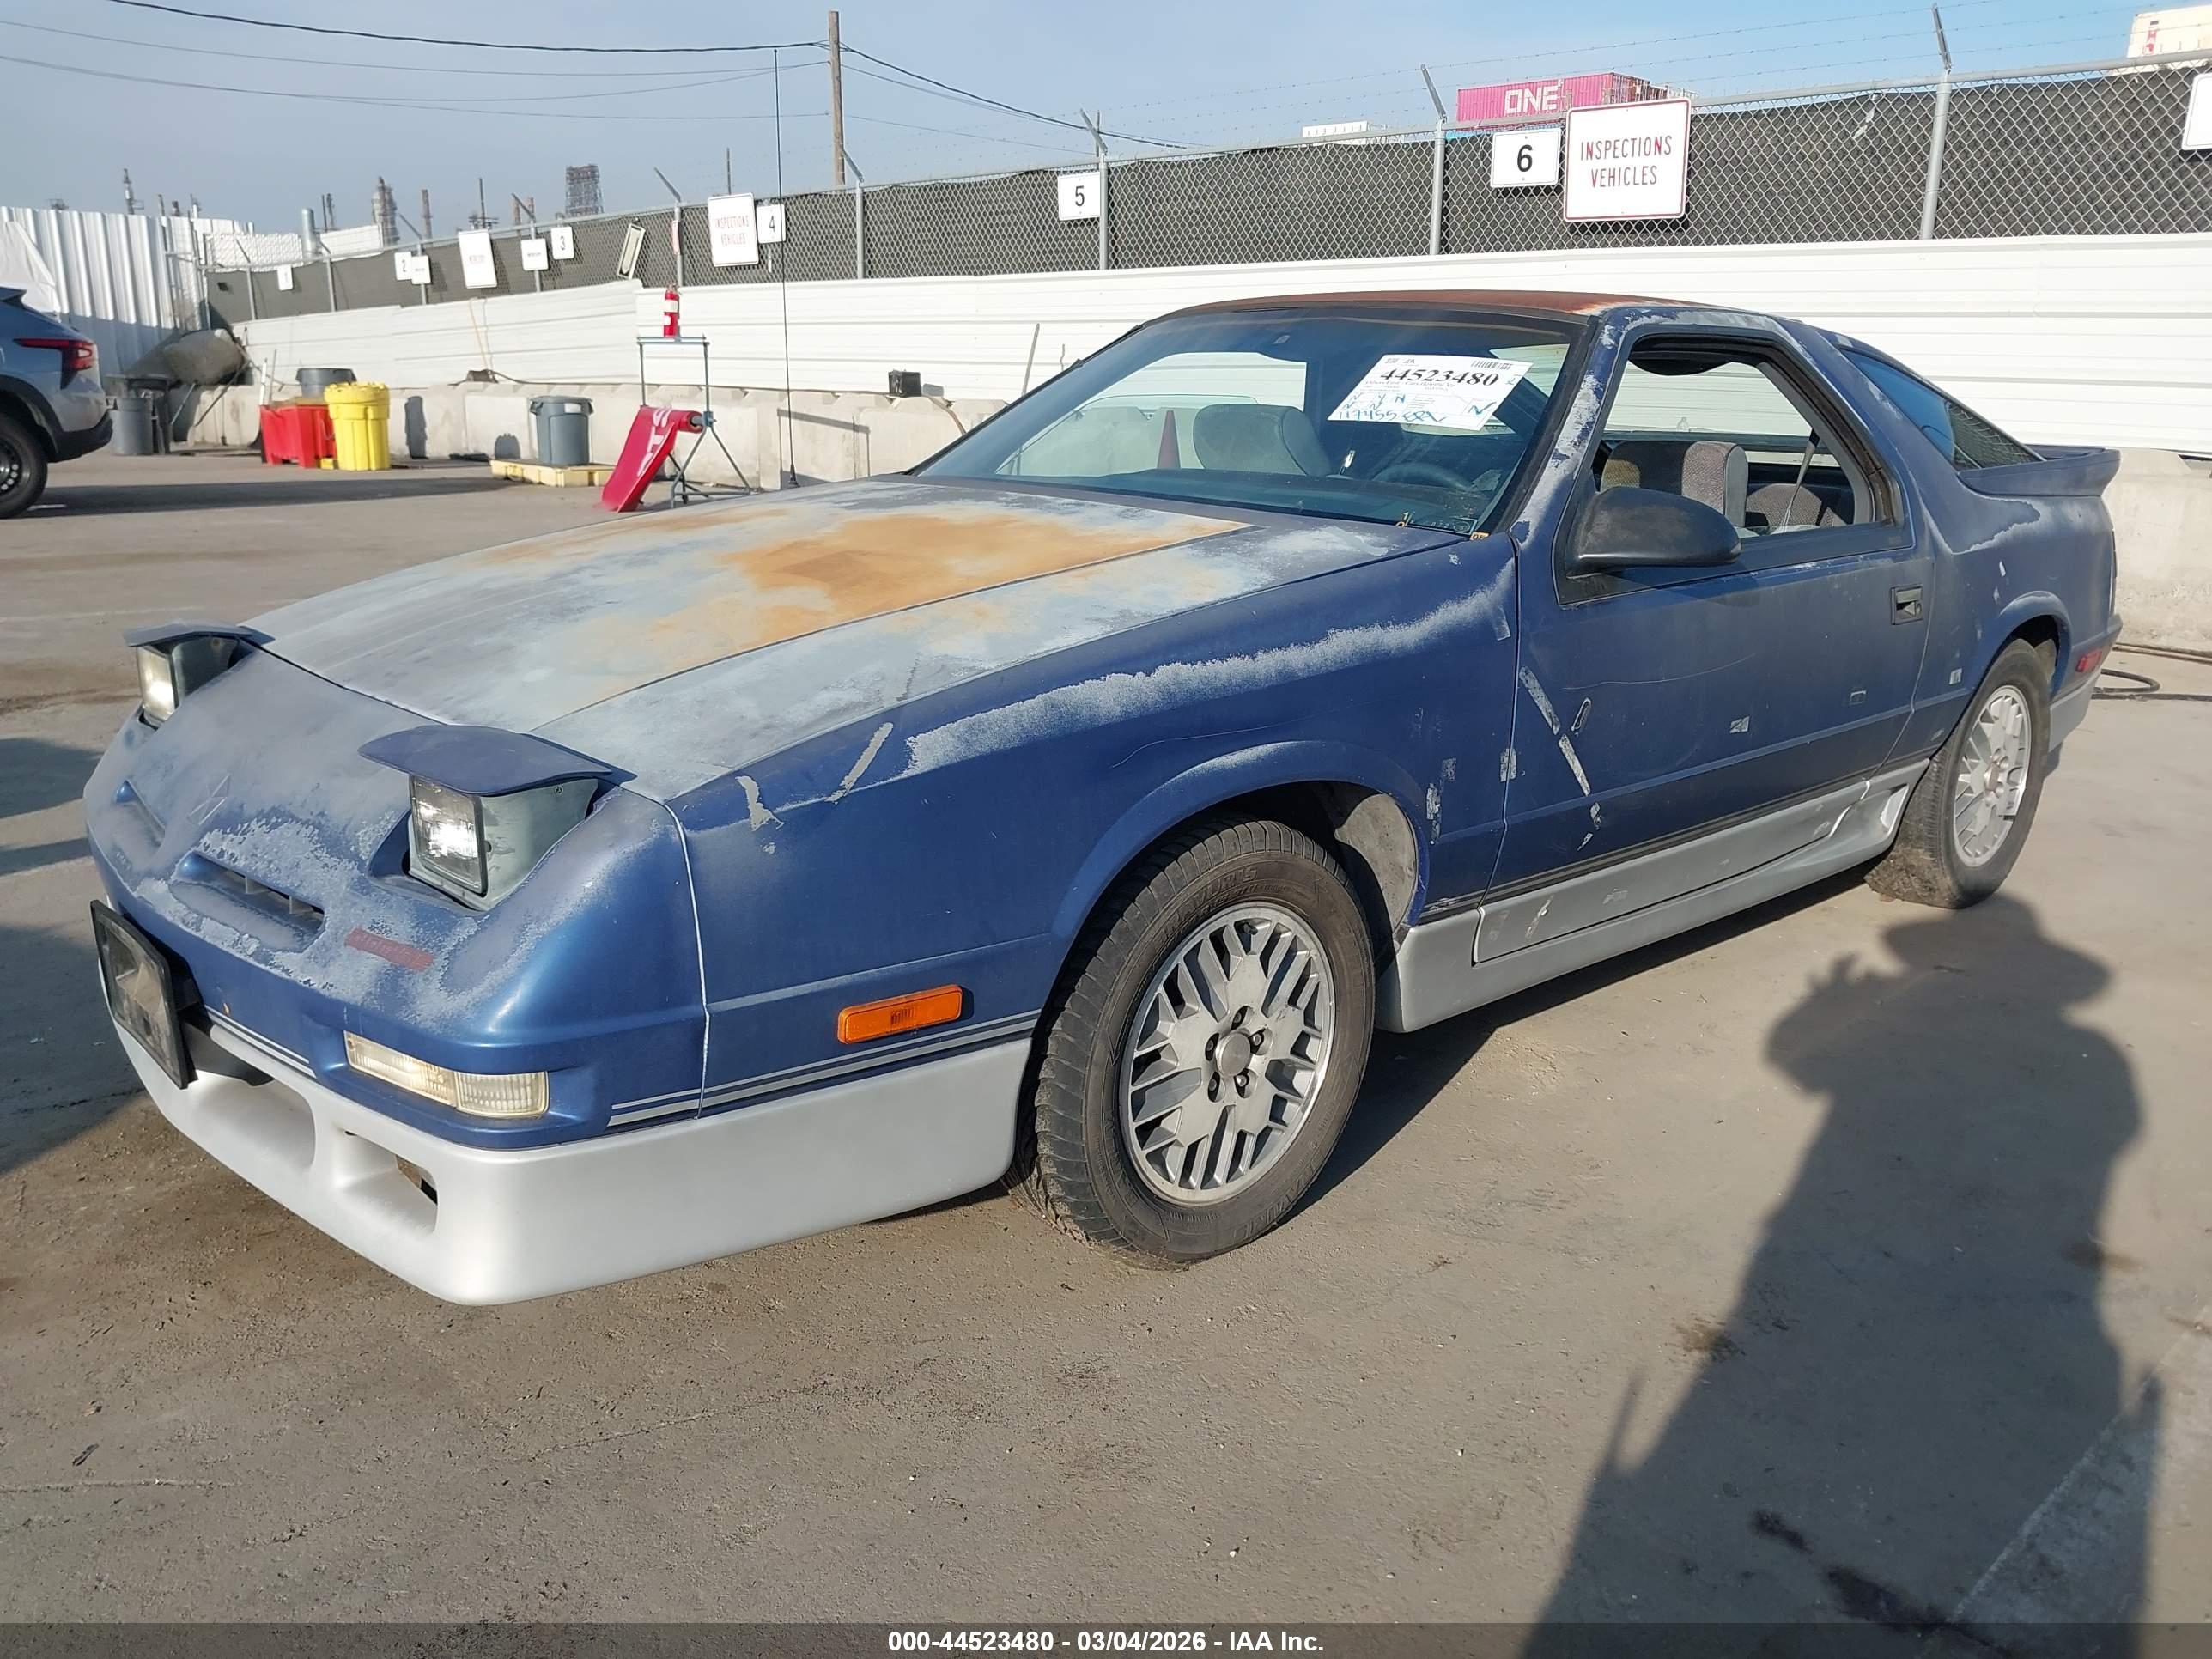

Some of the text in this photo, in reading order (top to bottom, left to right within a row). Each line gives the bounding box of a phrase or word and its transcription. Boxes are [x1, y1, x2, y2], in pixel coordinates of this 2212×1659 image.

[1504, 85, 1559, 113] ONE
[1580, 135, 1673, 161] INSPECTIONS
[1516, 144, 1533, 173] 6
[1590, 165, 1658, 188] VEHICLES
[1075, 185, 1085, 207] 5
[714, 216, 750, 230] INSPECTIONS
[769, 215, 775, 233] 4
[559, 235, 567, 251] 3
[401, 258, 408, 273] 2
[1380, 368, 1499, 386] 44523480
